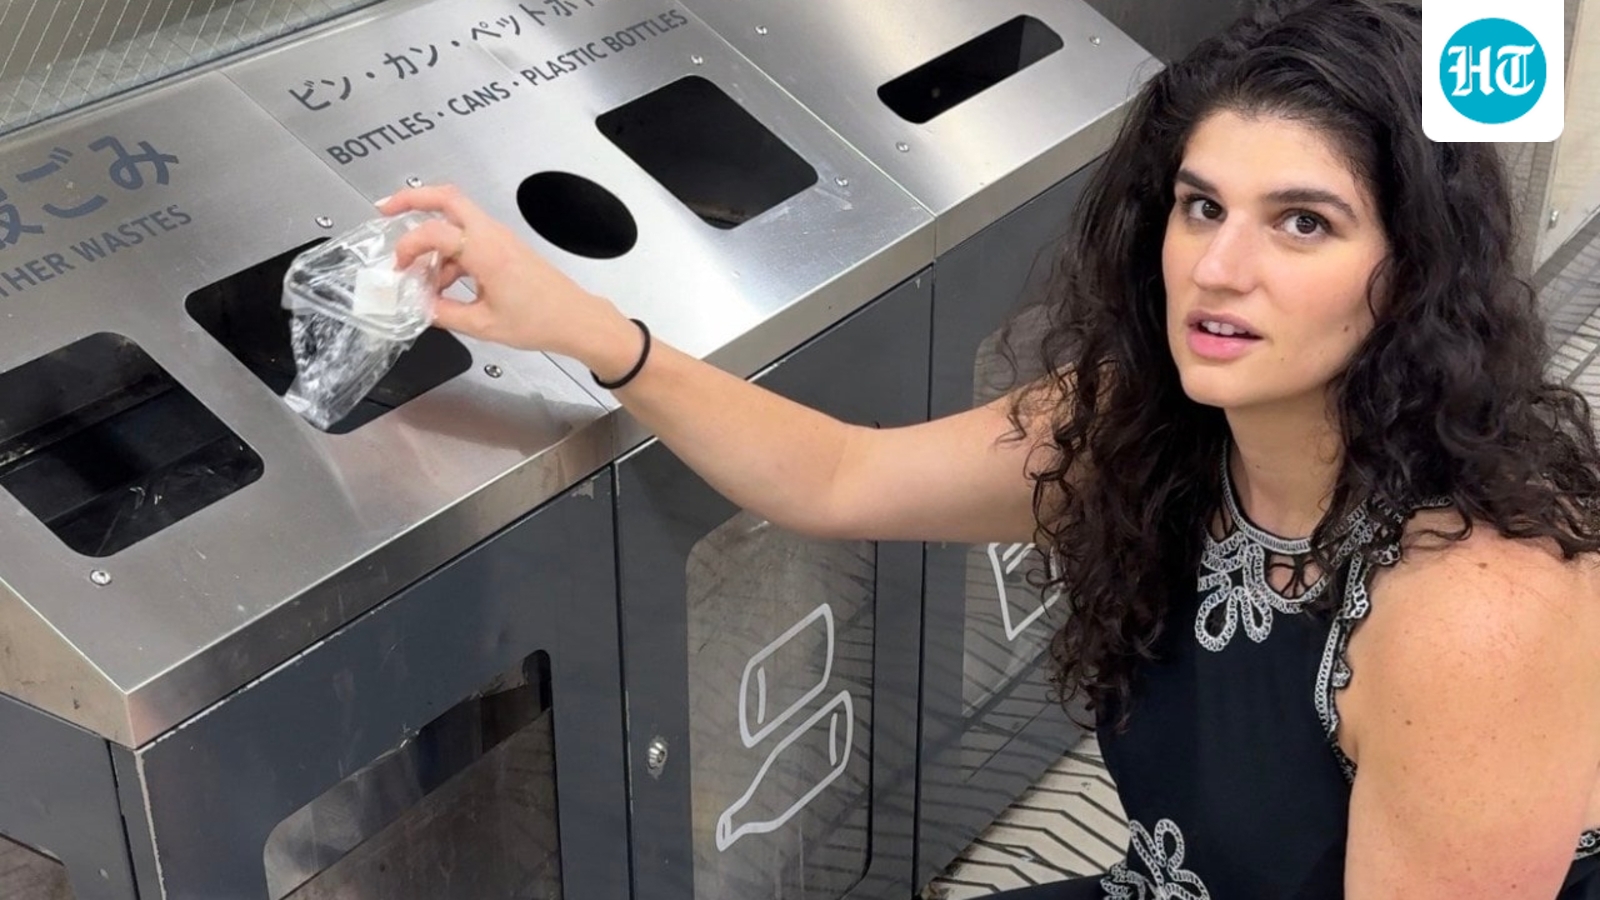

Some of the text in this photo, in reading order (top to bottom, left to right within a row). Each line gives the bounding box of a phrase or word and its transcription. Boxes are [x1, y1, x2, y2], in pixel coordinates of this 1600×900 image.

[325, 8, 689, 166] BOTTLES CANS PLASTIC BOTTLES
[0, 203, 193, 298] HER WASTES
